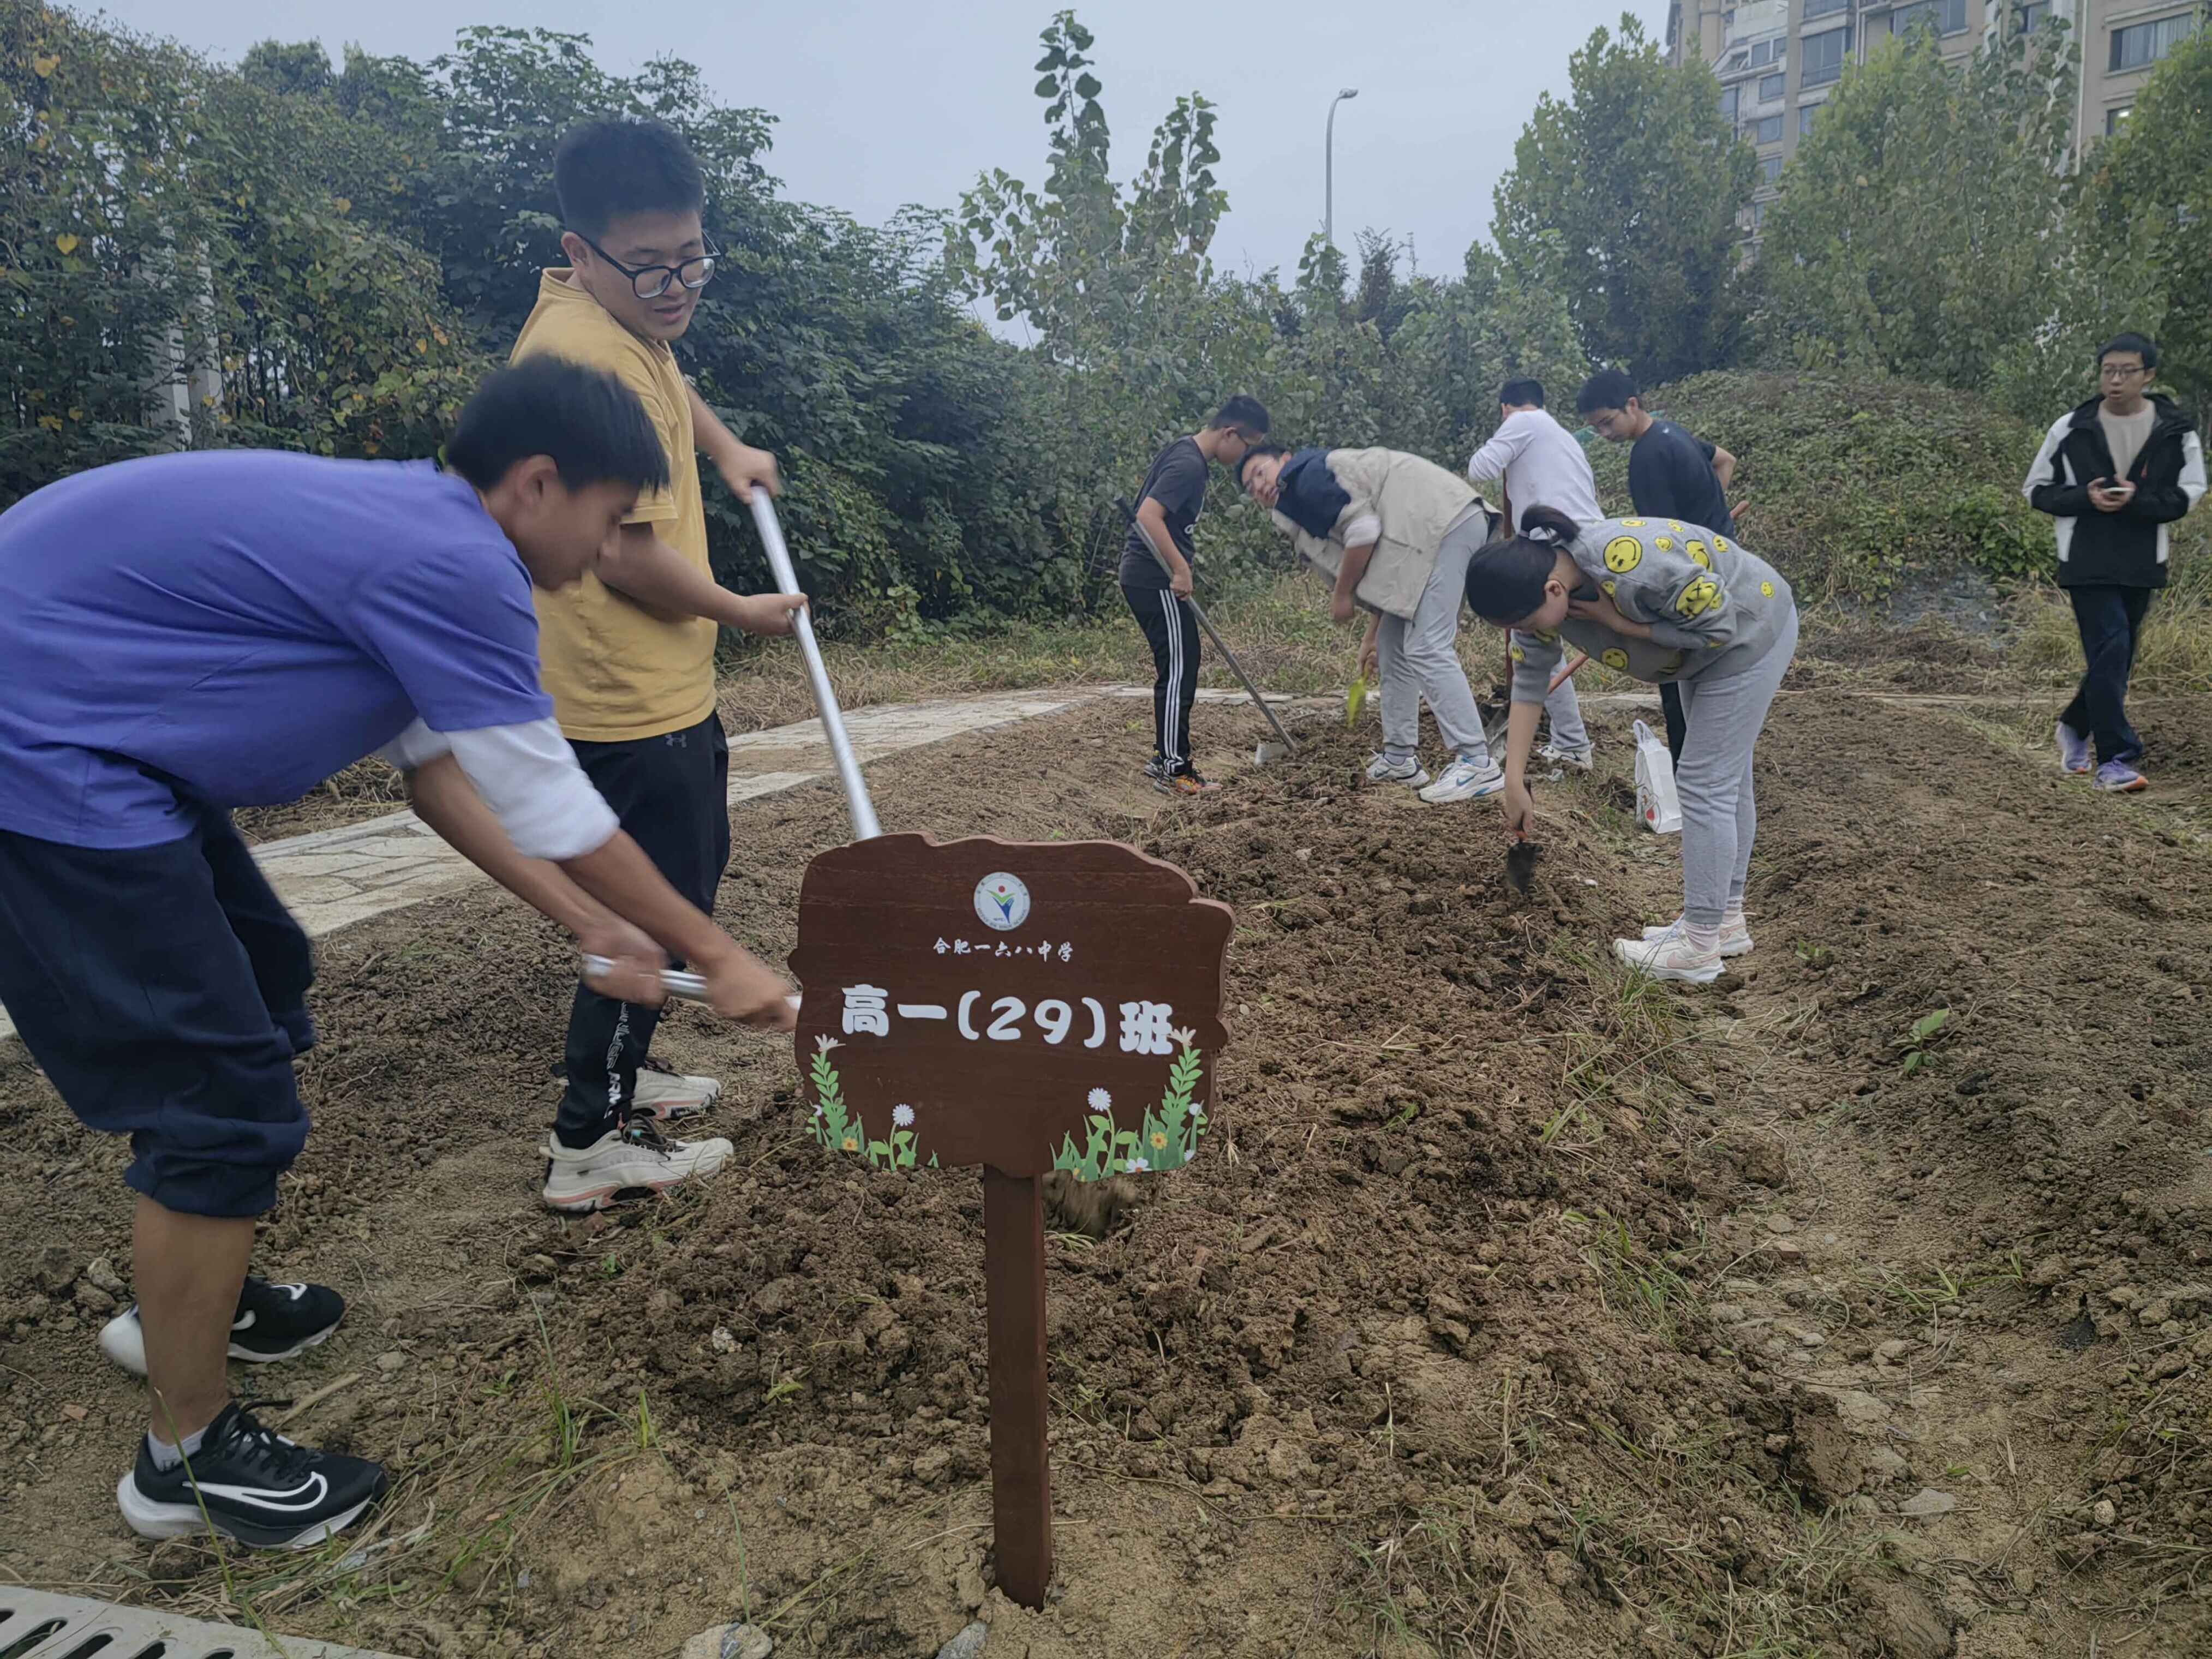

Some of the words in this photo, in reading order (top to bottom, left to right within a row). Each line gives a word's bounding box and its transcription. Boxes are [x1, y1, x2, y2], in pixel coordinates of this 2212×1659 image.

[933, 937, 1074, 962] 合肥一六八中学
[841, 984, 1173, 1055] 高一(29)班
